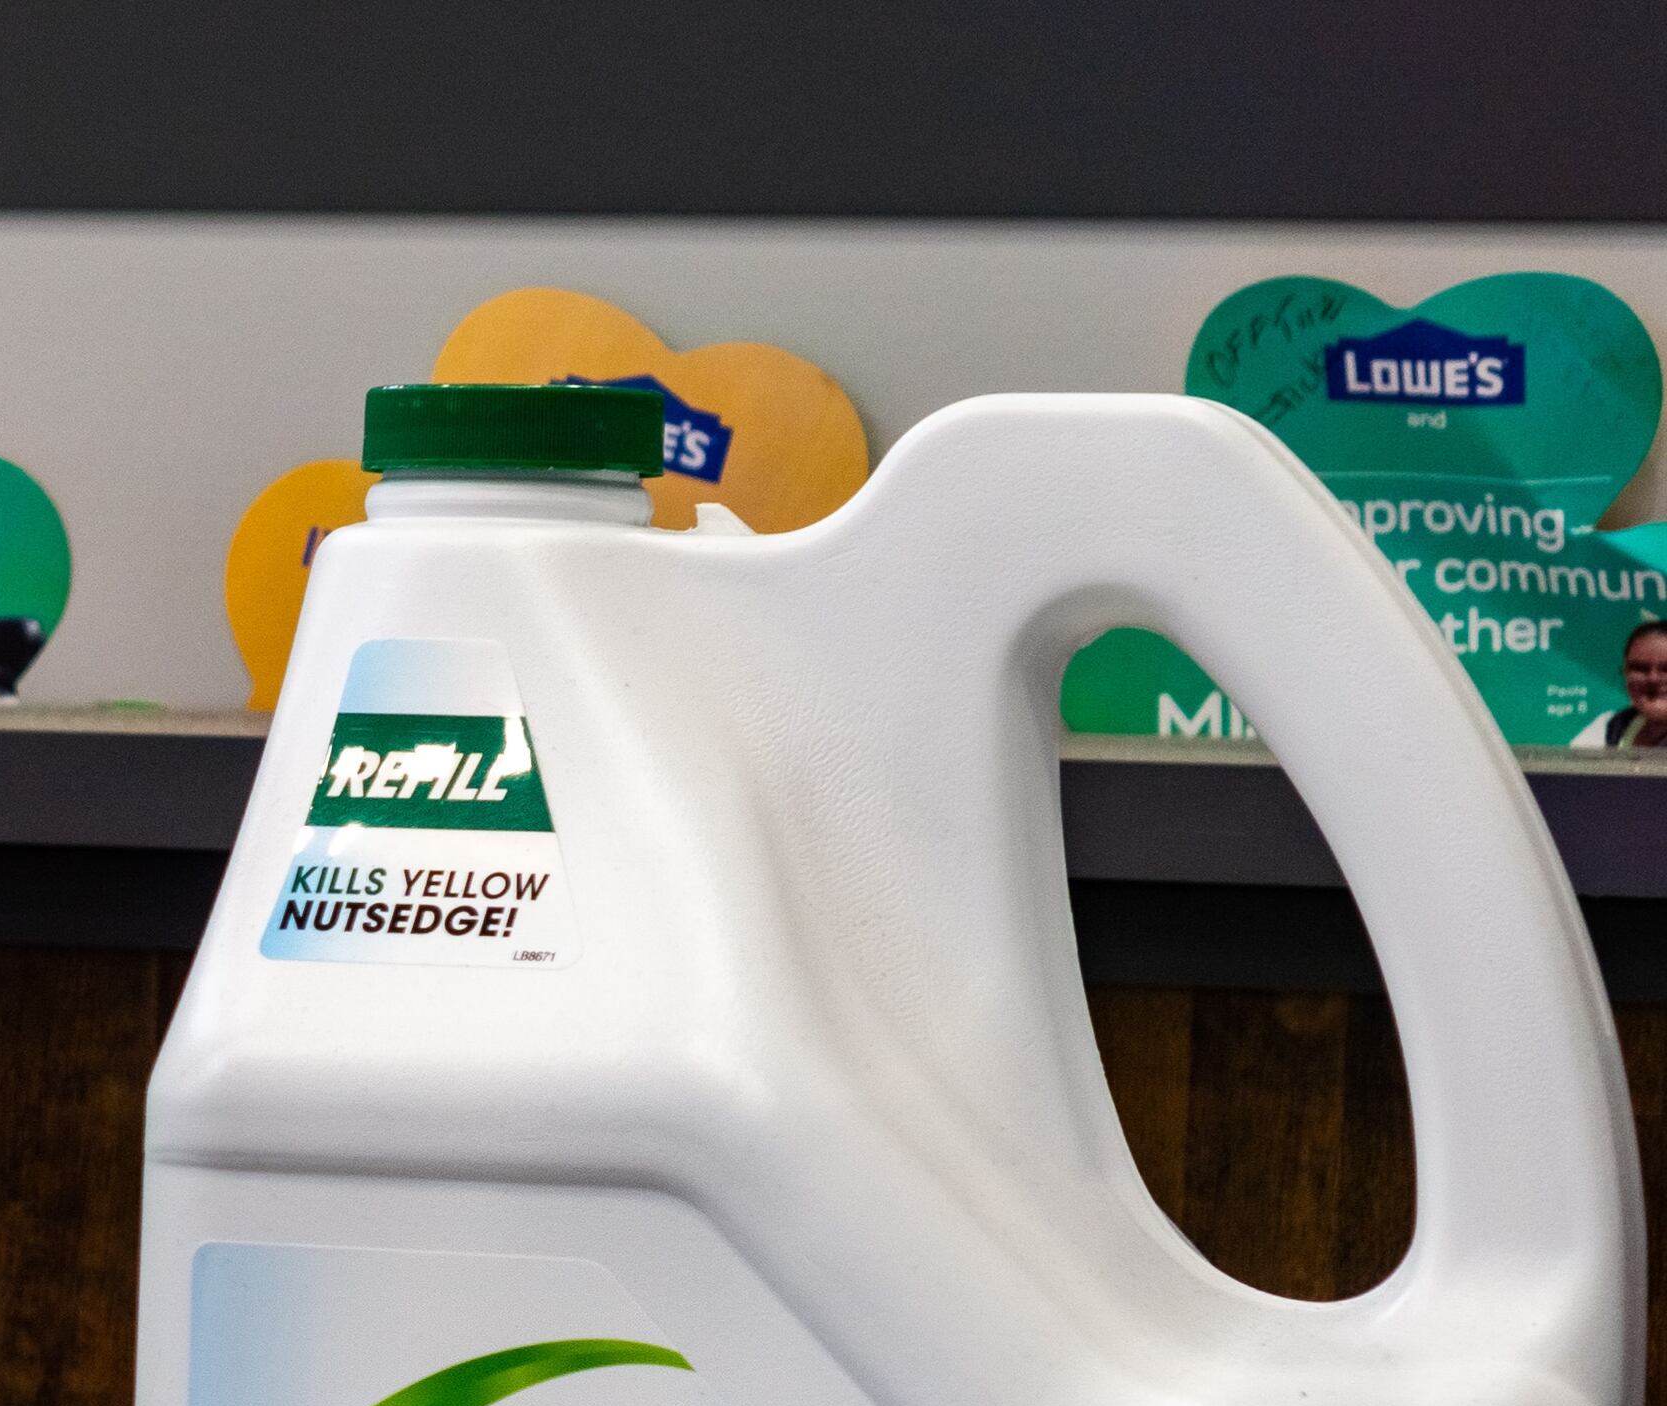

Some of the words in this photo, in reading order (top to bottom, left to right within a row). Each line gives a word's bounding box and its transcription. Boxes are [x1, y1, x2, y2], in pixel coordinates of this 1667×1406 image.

[1343, 349, 1503, 398] LOWE'S
[1407, 411, 1446, 429] and
[291, 866, 386, 895] KILLS
[403, 869, 550, 900] YELLOW
[279, 900, 518, 937] NUTSEDGE!
[513, 950, 555, 962] LB8671
